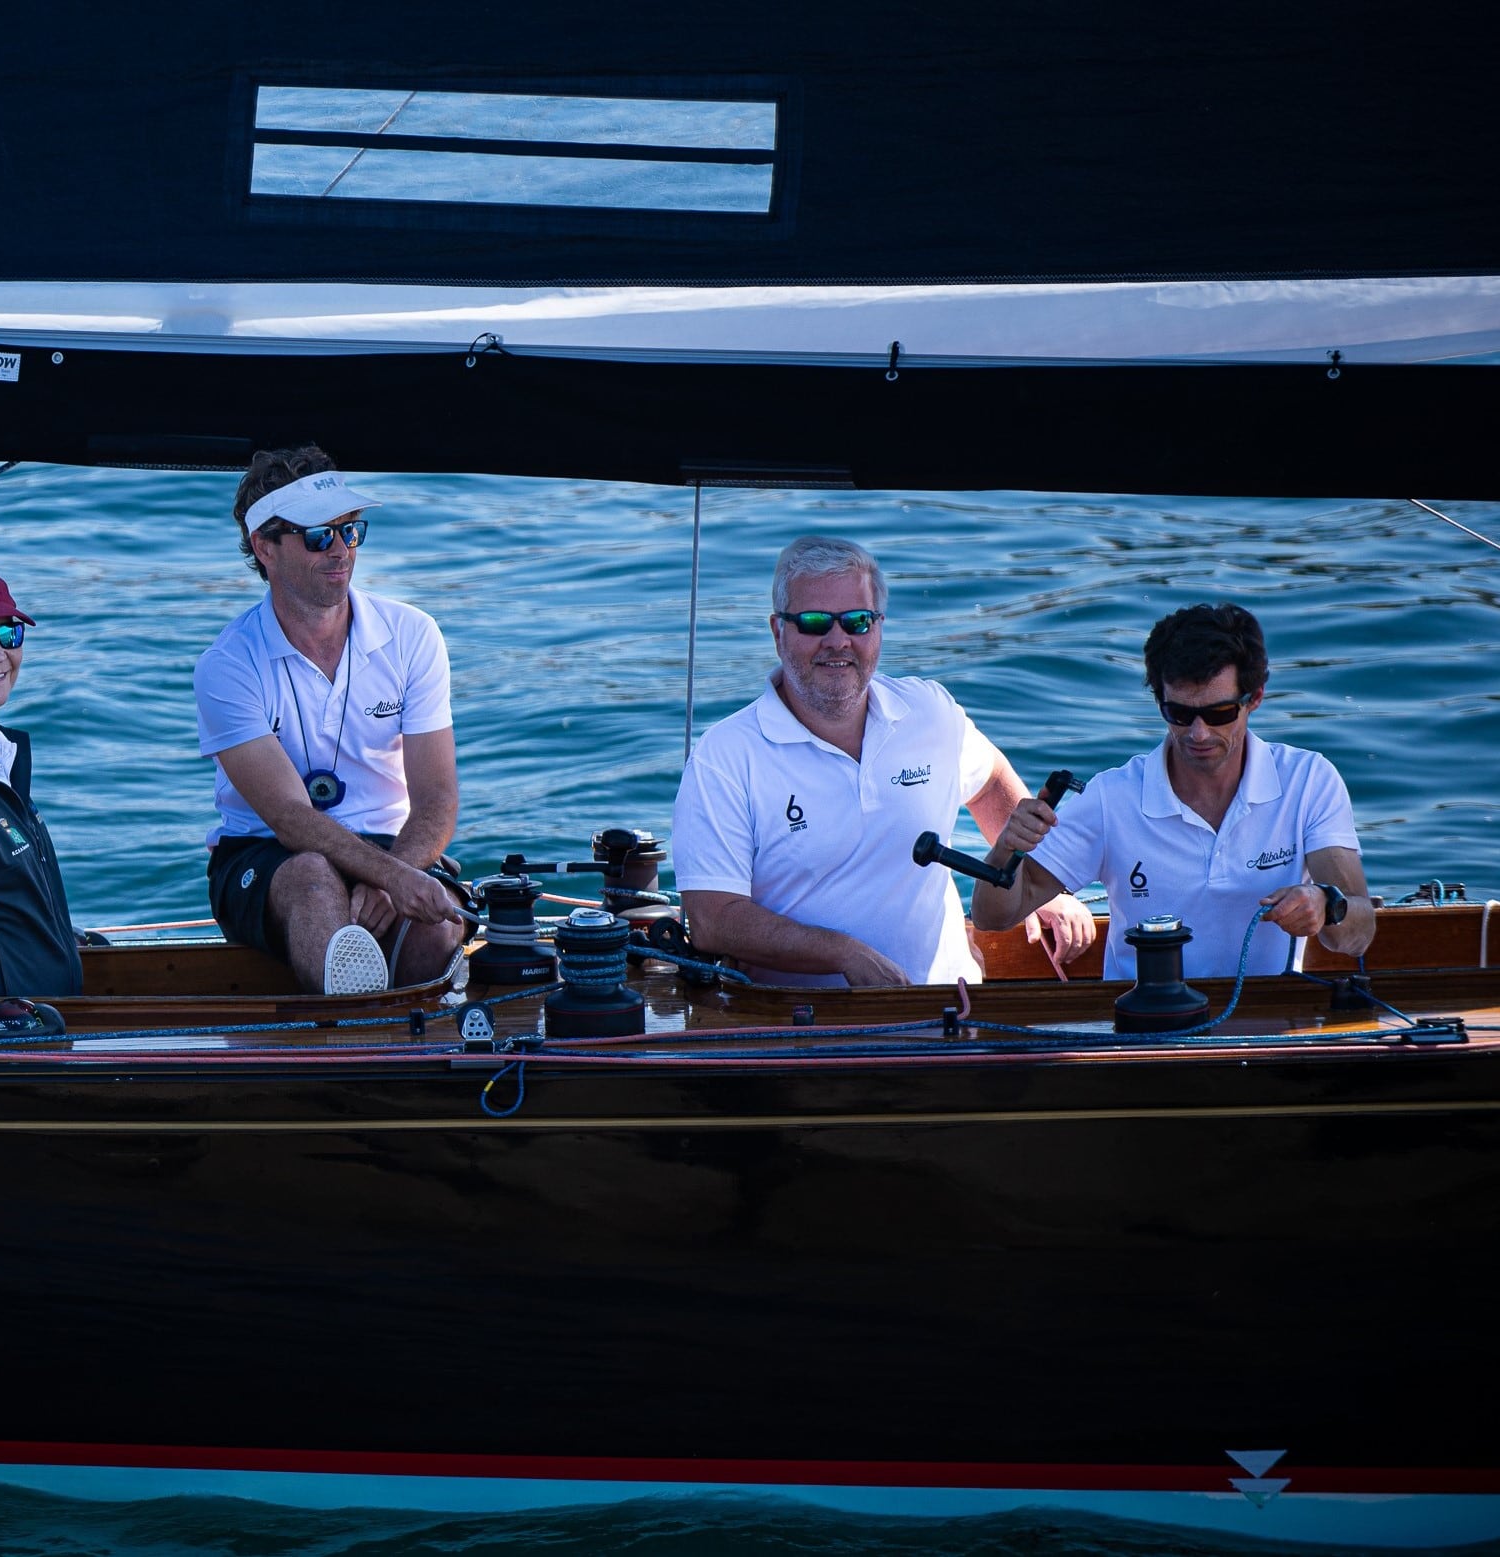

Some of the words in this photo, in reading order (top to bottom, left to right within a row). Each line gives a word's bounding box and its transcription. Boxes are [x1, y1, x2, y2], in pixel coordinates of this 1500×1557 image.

[313, 477, 338, 490] HH
[364, 699, 404, 716] Alibab
[891, 766, 926, 784] Alibaba
[786, 794, 804, 822] 6
[1246, 847, 1291, 869] Alibaba
[1130, 860, 1147, 889] 6
